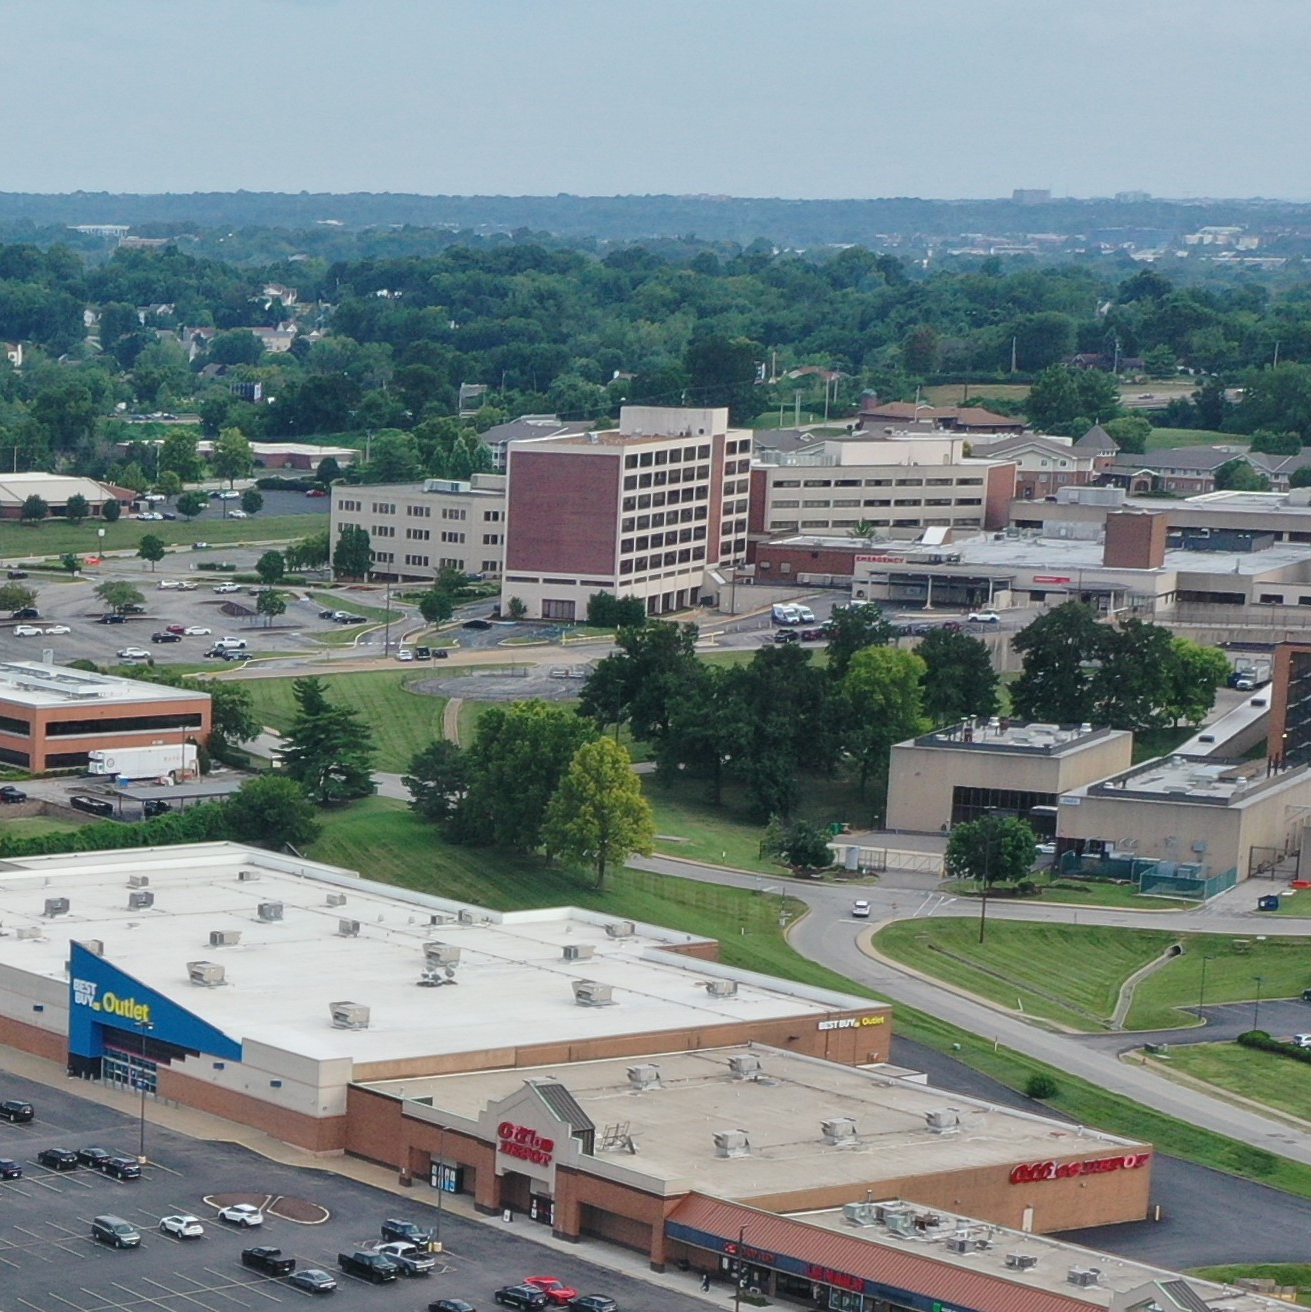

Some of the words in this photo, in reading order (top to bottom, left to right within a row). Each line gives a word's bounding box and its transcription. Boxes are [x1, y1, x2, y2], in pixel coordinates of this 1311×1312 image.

[855, 555, 905, 564] EMERGENCY
[73, 978, 97, 996] BEST
[75, 991, 95, 1007] BUY
[103, 991, 149, 1022] Outlet
